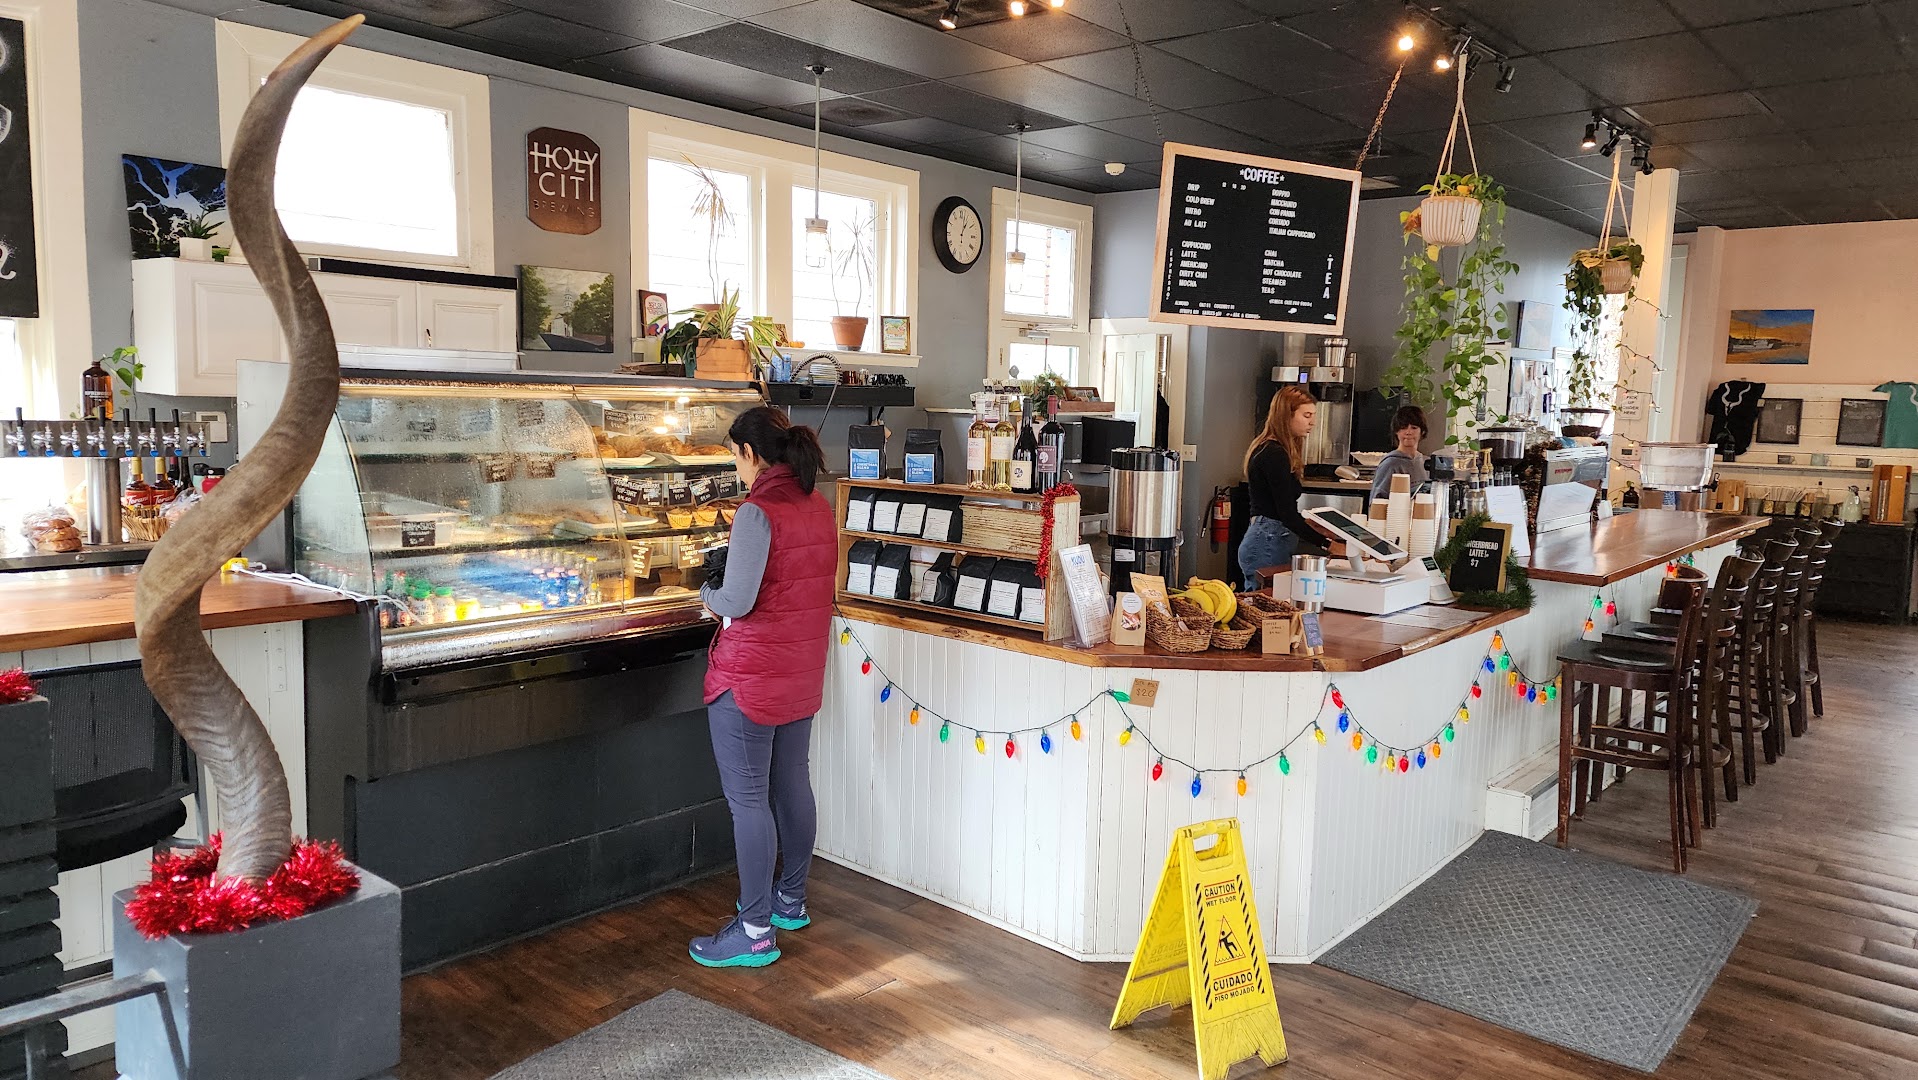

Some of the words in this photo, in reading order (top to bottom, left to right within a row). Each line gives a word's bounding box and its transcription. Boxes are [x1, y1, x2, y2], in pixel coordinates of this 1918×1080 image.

[529, 142, 599, 184] HOLY
[1187, 183, 1200, 191] DRIP
[1186, 195, 1199, 203] COLD
[1200, 197, 1215, 205] BREW
[1185, 207, 1201, 215] NITRO
[1181, 250, 1197, 258] LATTE
[1180, 260, 1208, 269] AMERICANO
[1263, 259, 1284, 267] MATCHA
[1274, 270, 1302, 278] CHOCOLATE
[1179, 279, 1197, 287] MOCHA
[126, 495, 149, 505] Torani
[1470, 558, 1479, 567] $7
[1136, 688, 1155, 697] $20
[1205, 883, 1235, 897] CAUTION
[1219, 896, 1236, 904] FLOOR
[751, 939, 771, 952] HOKA
[1214, 972, 1252, 991] CUIDADO
[1215, 994, 1228, 1003] PISO
[1230, 986, 1254, 998] MOJADO
